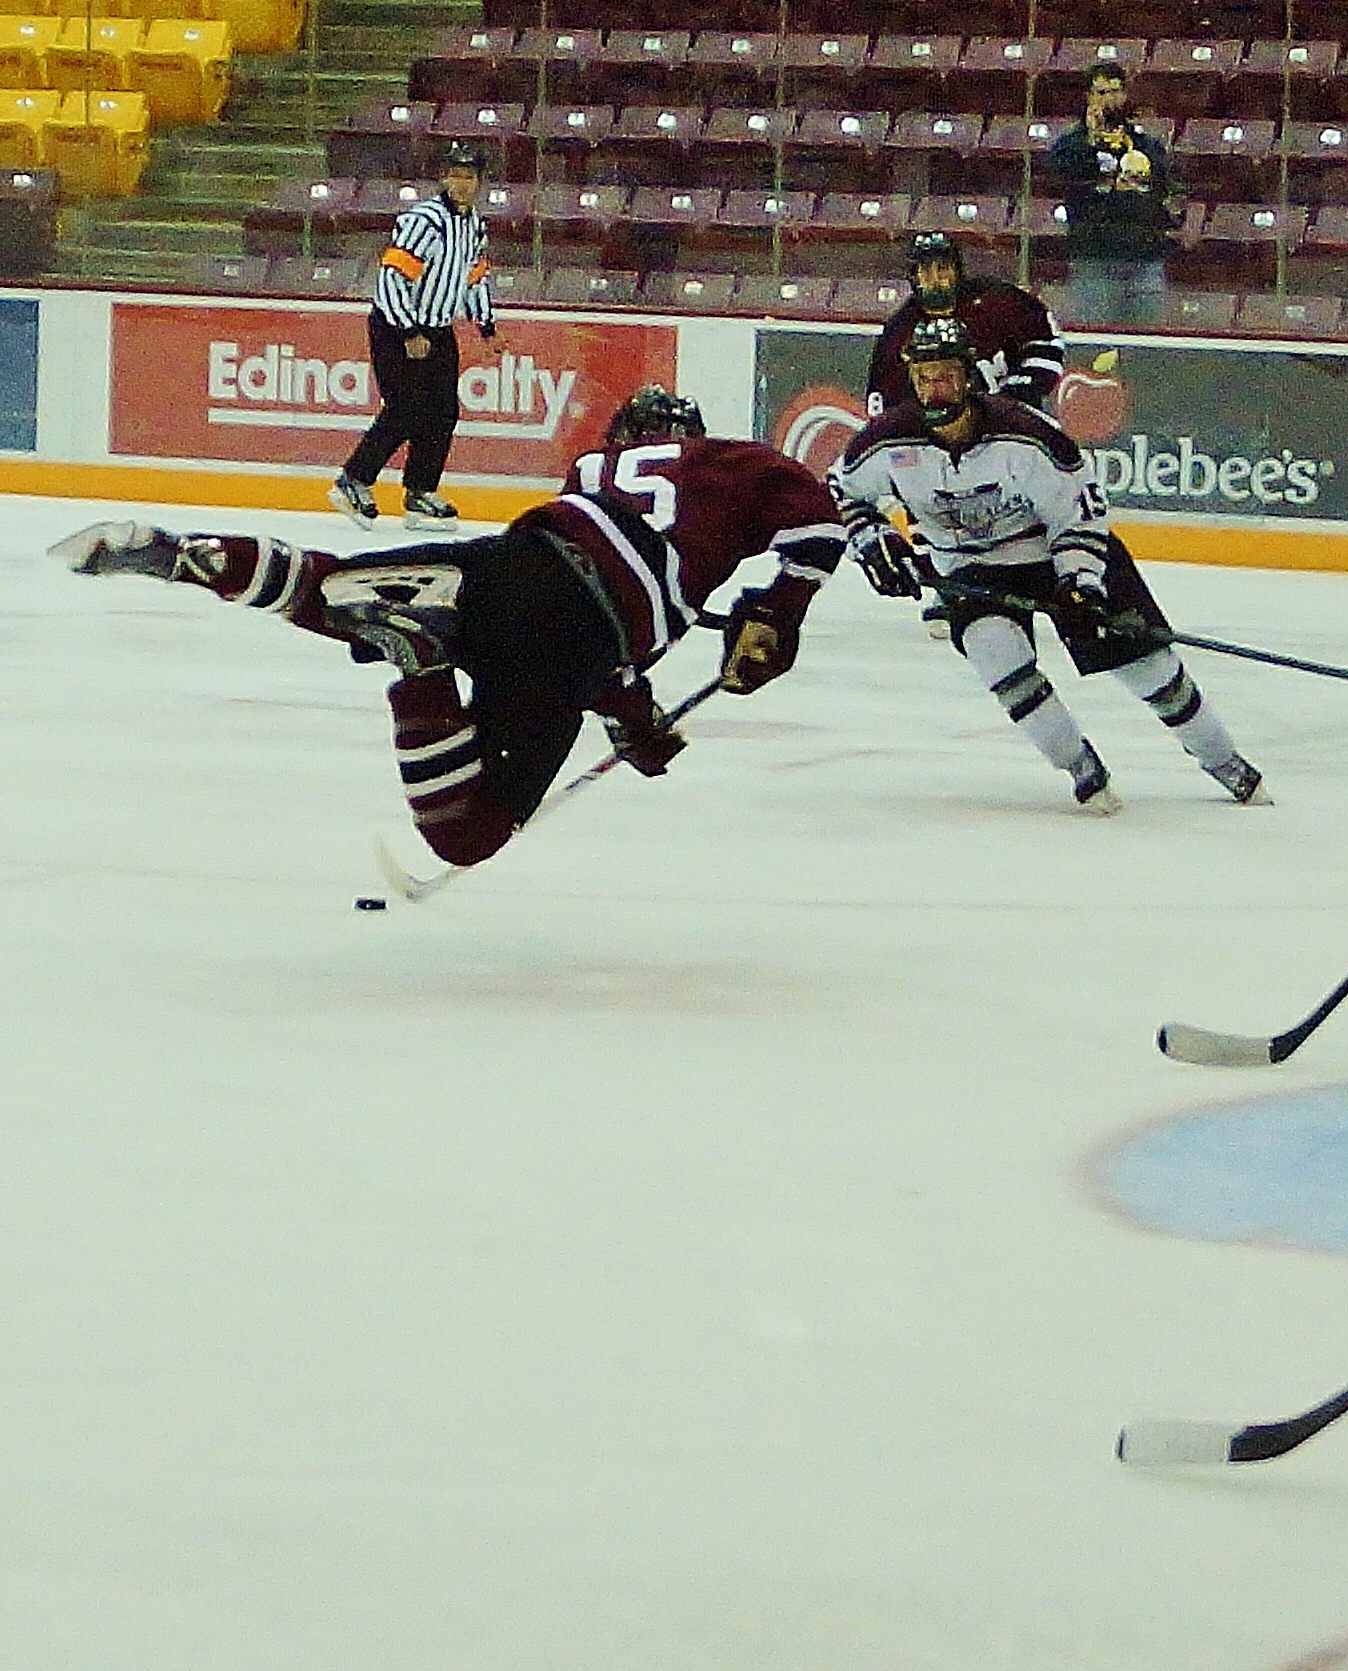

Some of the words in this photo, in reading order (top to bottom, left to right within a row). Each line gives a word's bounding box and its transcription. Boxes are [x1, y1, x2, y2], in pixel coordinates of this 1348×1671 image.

[208, 341, 370, 406] Edina
[457, 350, 577, 439] alty
[575, 443, 682, 532] 15
[1082, 434, 1320, 503] plebee's
